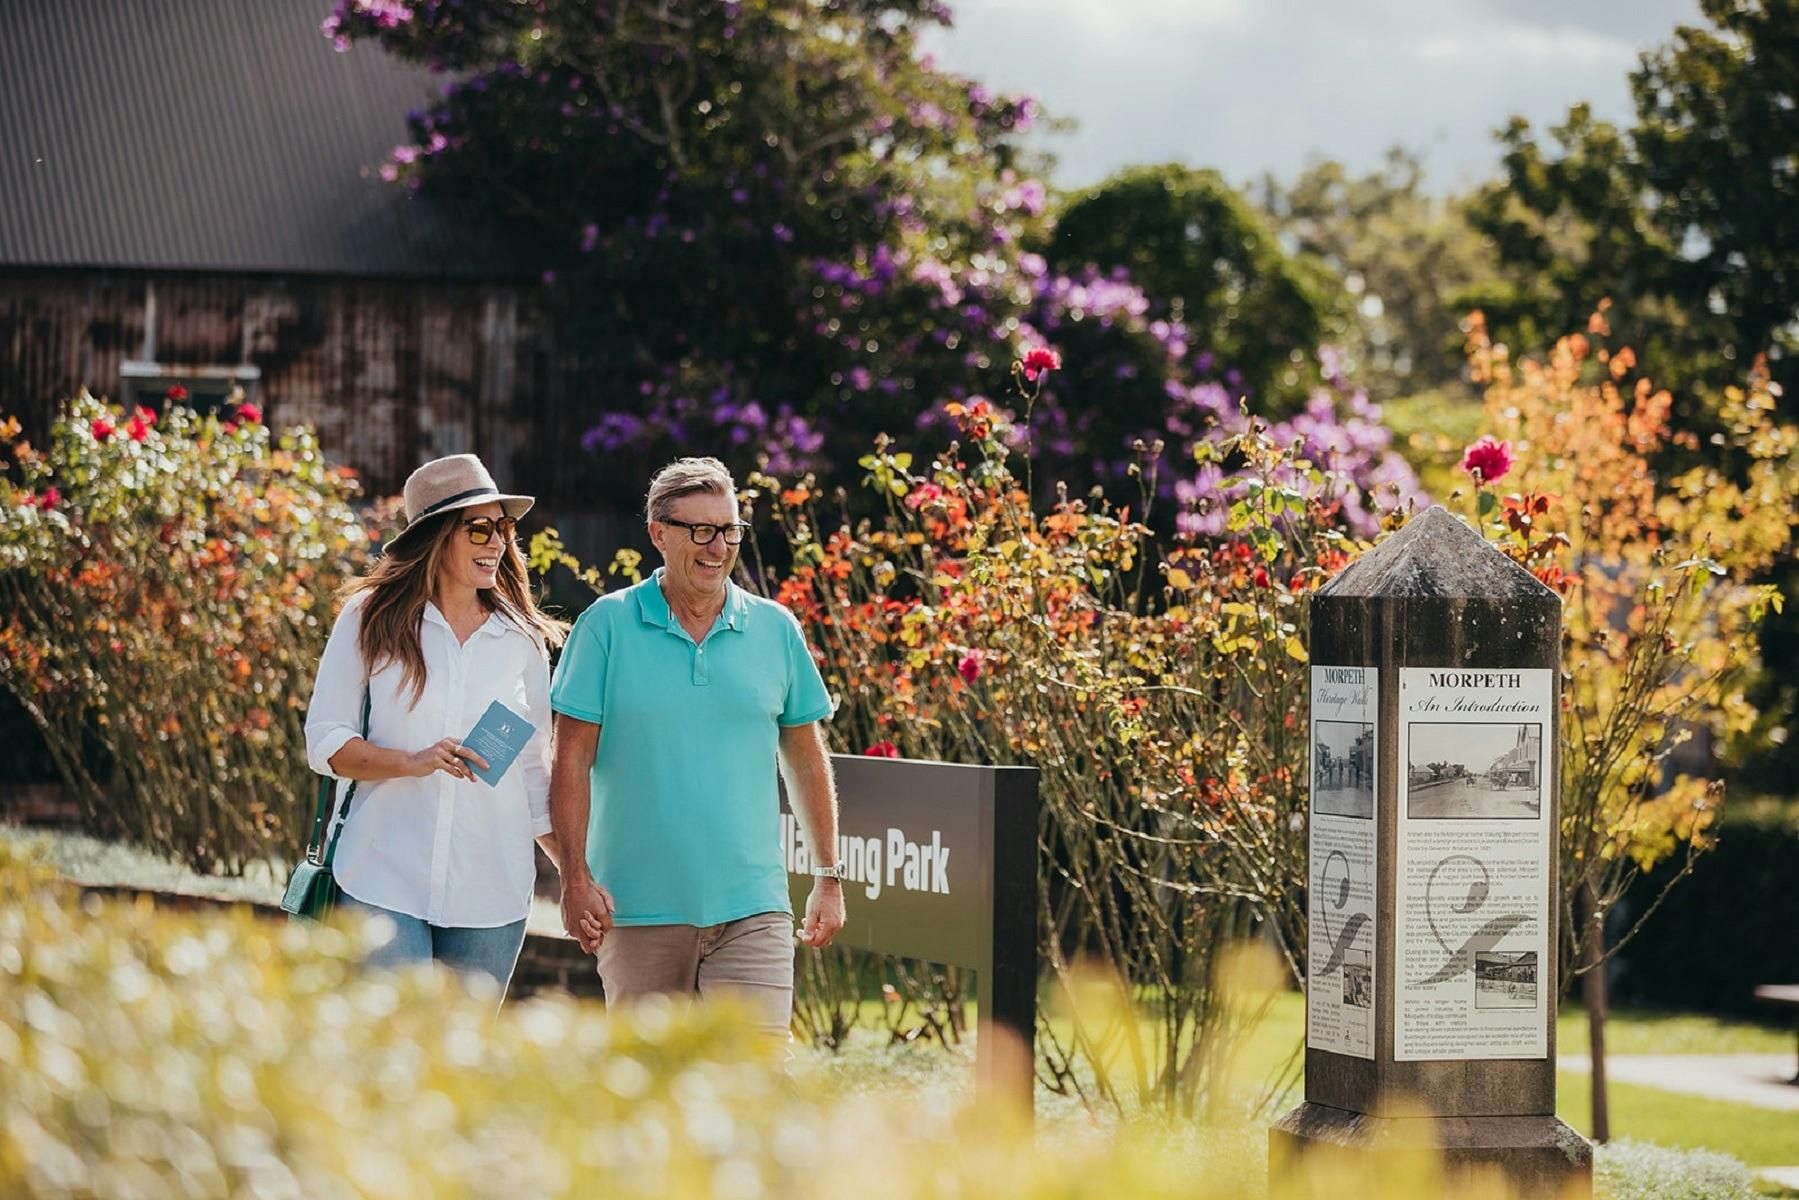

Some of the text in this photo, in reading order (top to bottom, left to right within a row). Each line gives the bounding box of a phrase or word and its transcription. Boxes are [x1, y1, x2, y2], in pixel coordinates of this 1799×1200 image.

[1324, 668, 1365, 685] MORPETH
[1429, 673, 1521, 688] MORPETH
[1409, 695, 1540, 713] An Introduction
[780, 813, 950, 900] llaung Park
